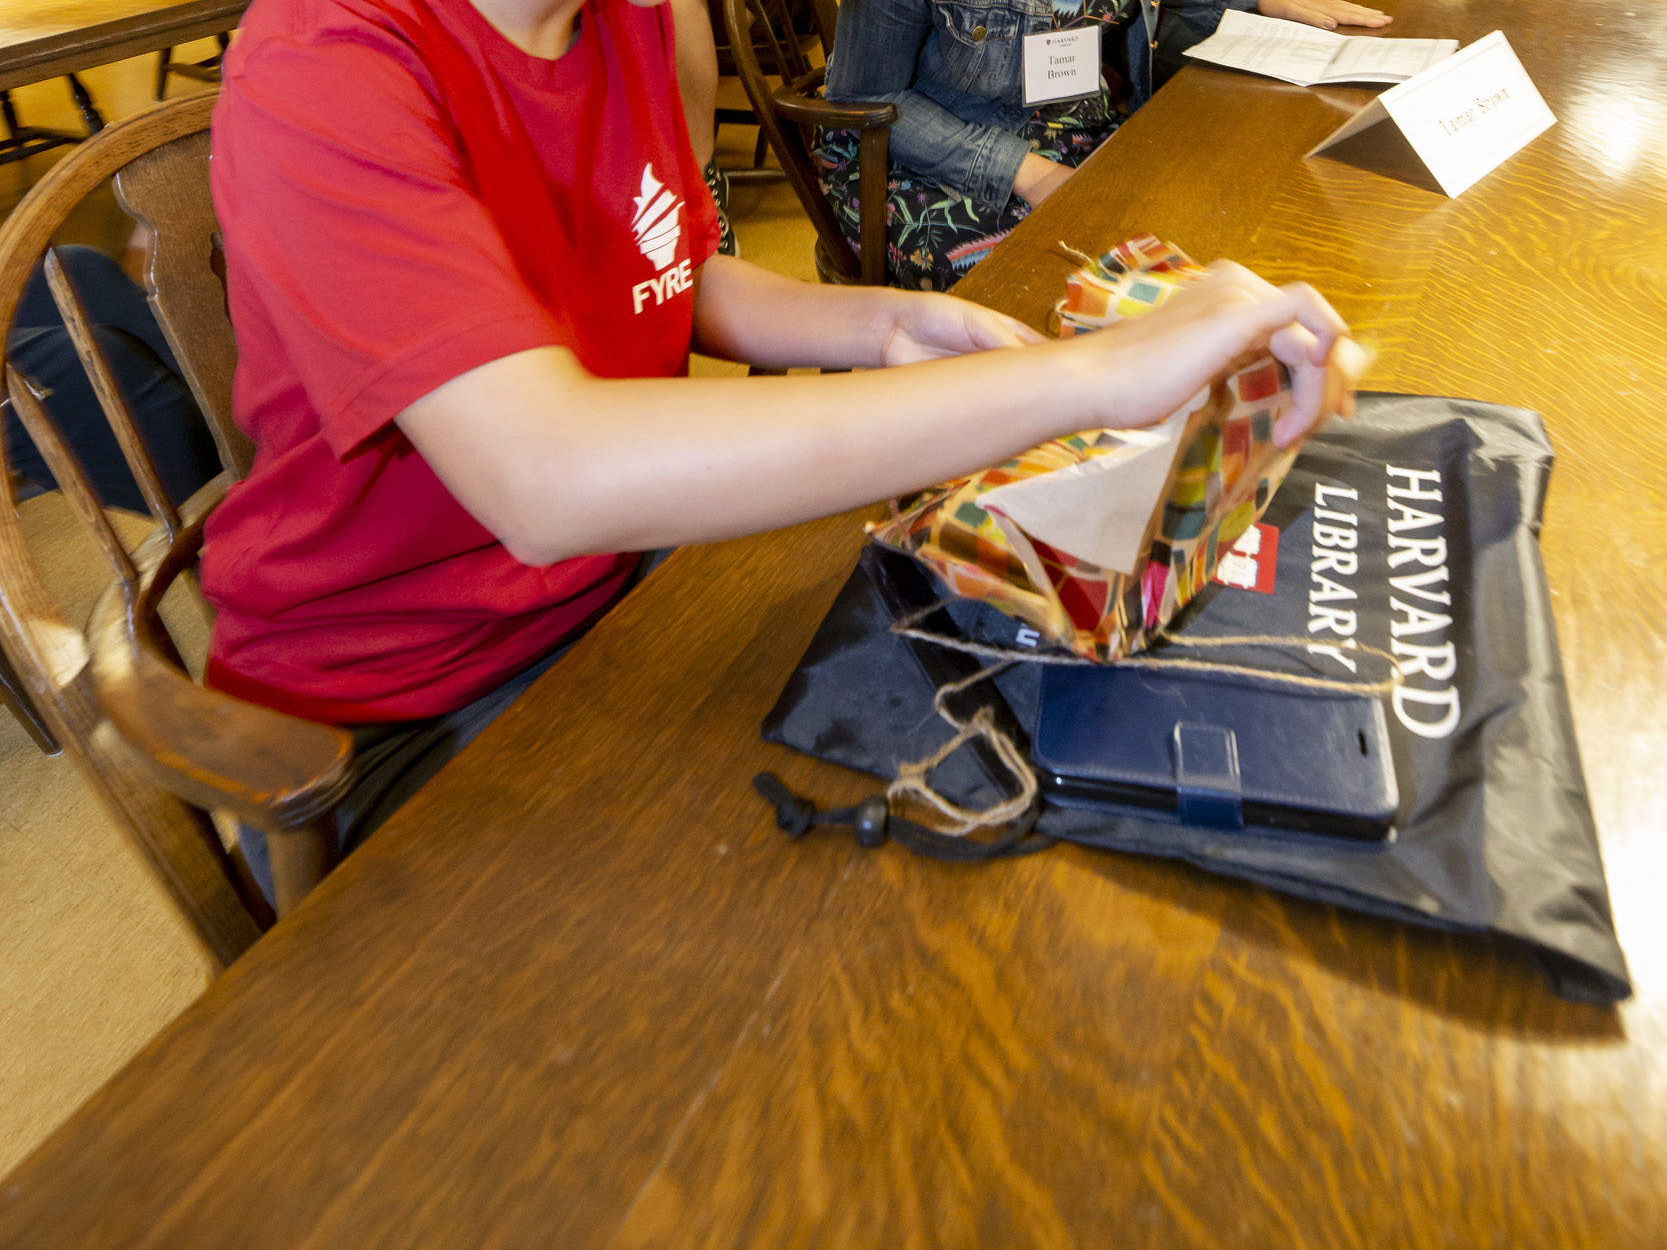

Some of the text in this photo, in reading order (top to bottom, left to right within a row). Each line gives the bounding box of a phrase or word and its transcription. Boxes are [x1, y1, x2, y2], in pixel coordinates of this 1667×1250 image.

[1047, 68, 1076, 79] Brown
[1048, 55, 1076, 65] Tamar
[632, 258, 693, 315] FYRE
[1307, 482, 1358, 673] LIBRARY
[1386, 463, 1461, 738] HARVARD
